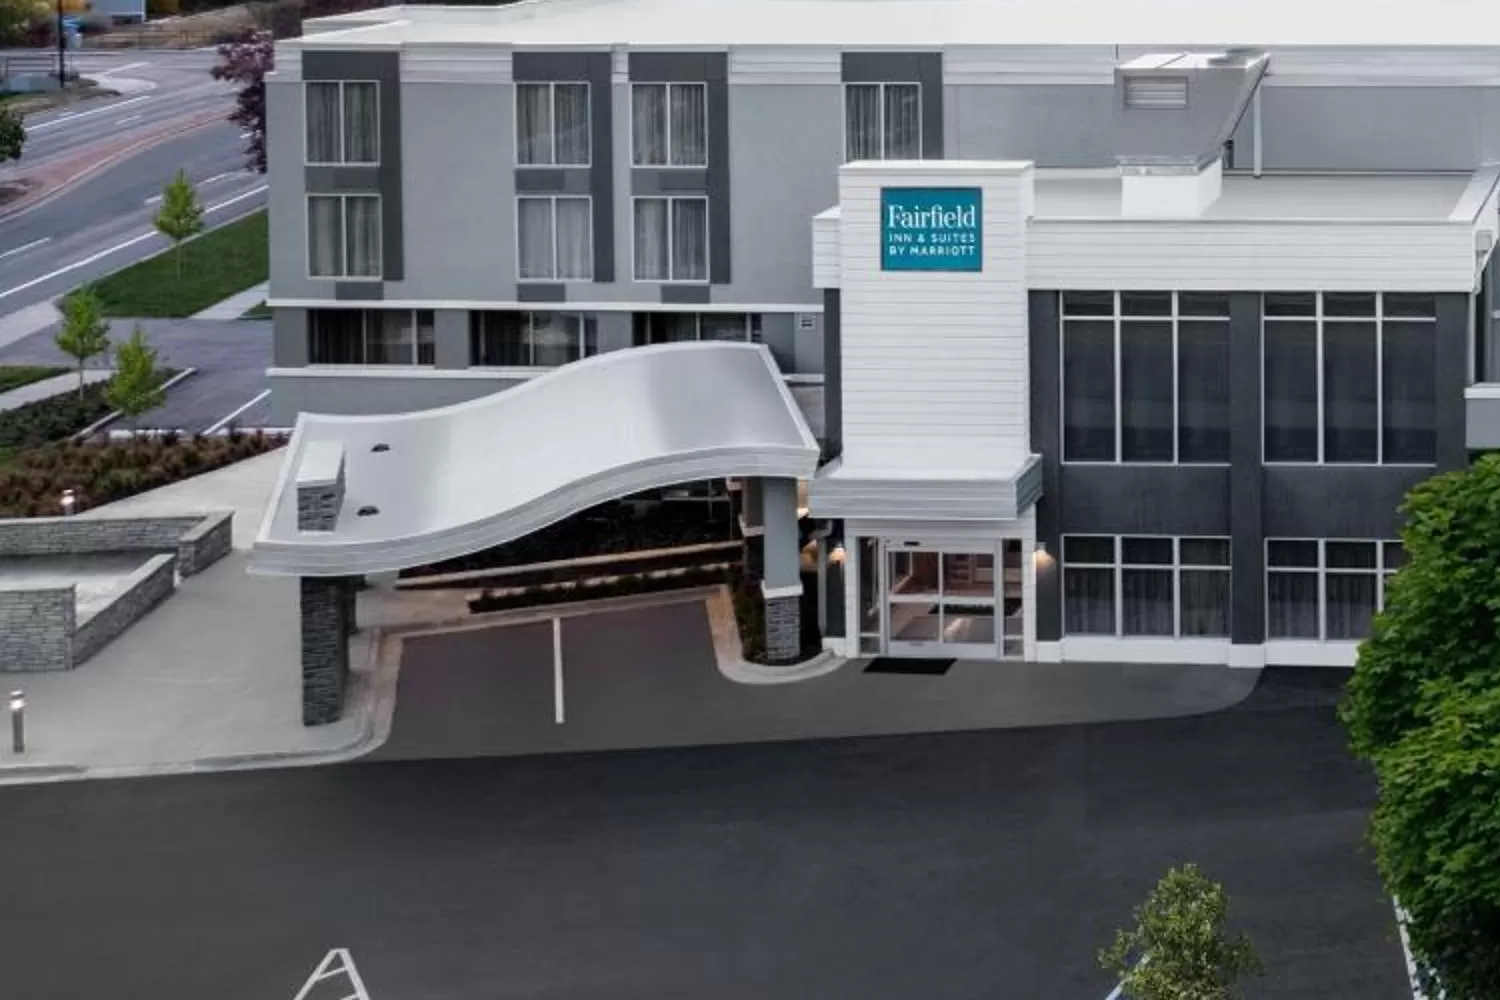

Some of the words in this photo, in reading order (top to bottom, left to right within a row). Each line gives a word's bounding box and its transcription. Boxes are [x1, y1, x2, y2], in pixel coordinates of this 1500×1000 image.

[888, 204, 976, 229] Fairfield
[889, 233, 912, 243] INN
[918, 233, 925, 243] &
[931, 233, 975, 243] SUITES
[889, 245, 905, 256] BY
[910, 245, 975, 256] MARRIOTT
